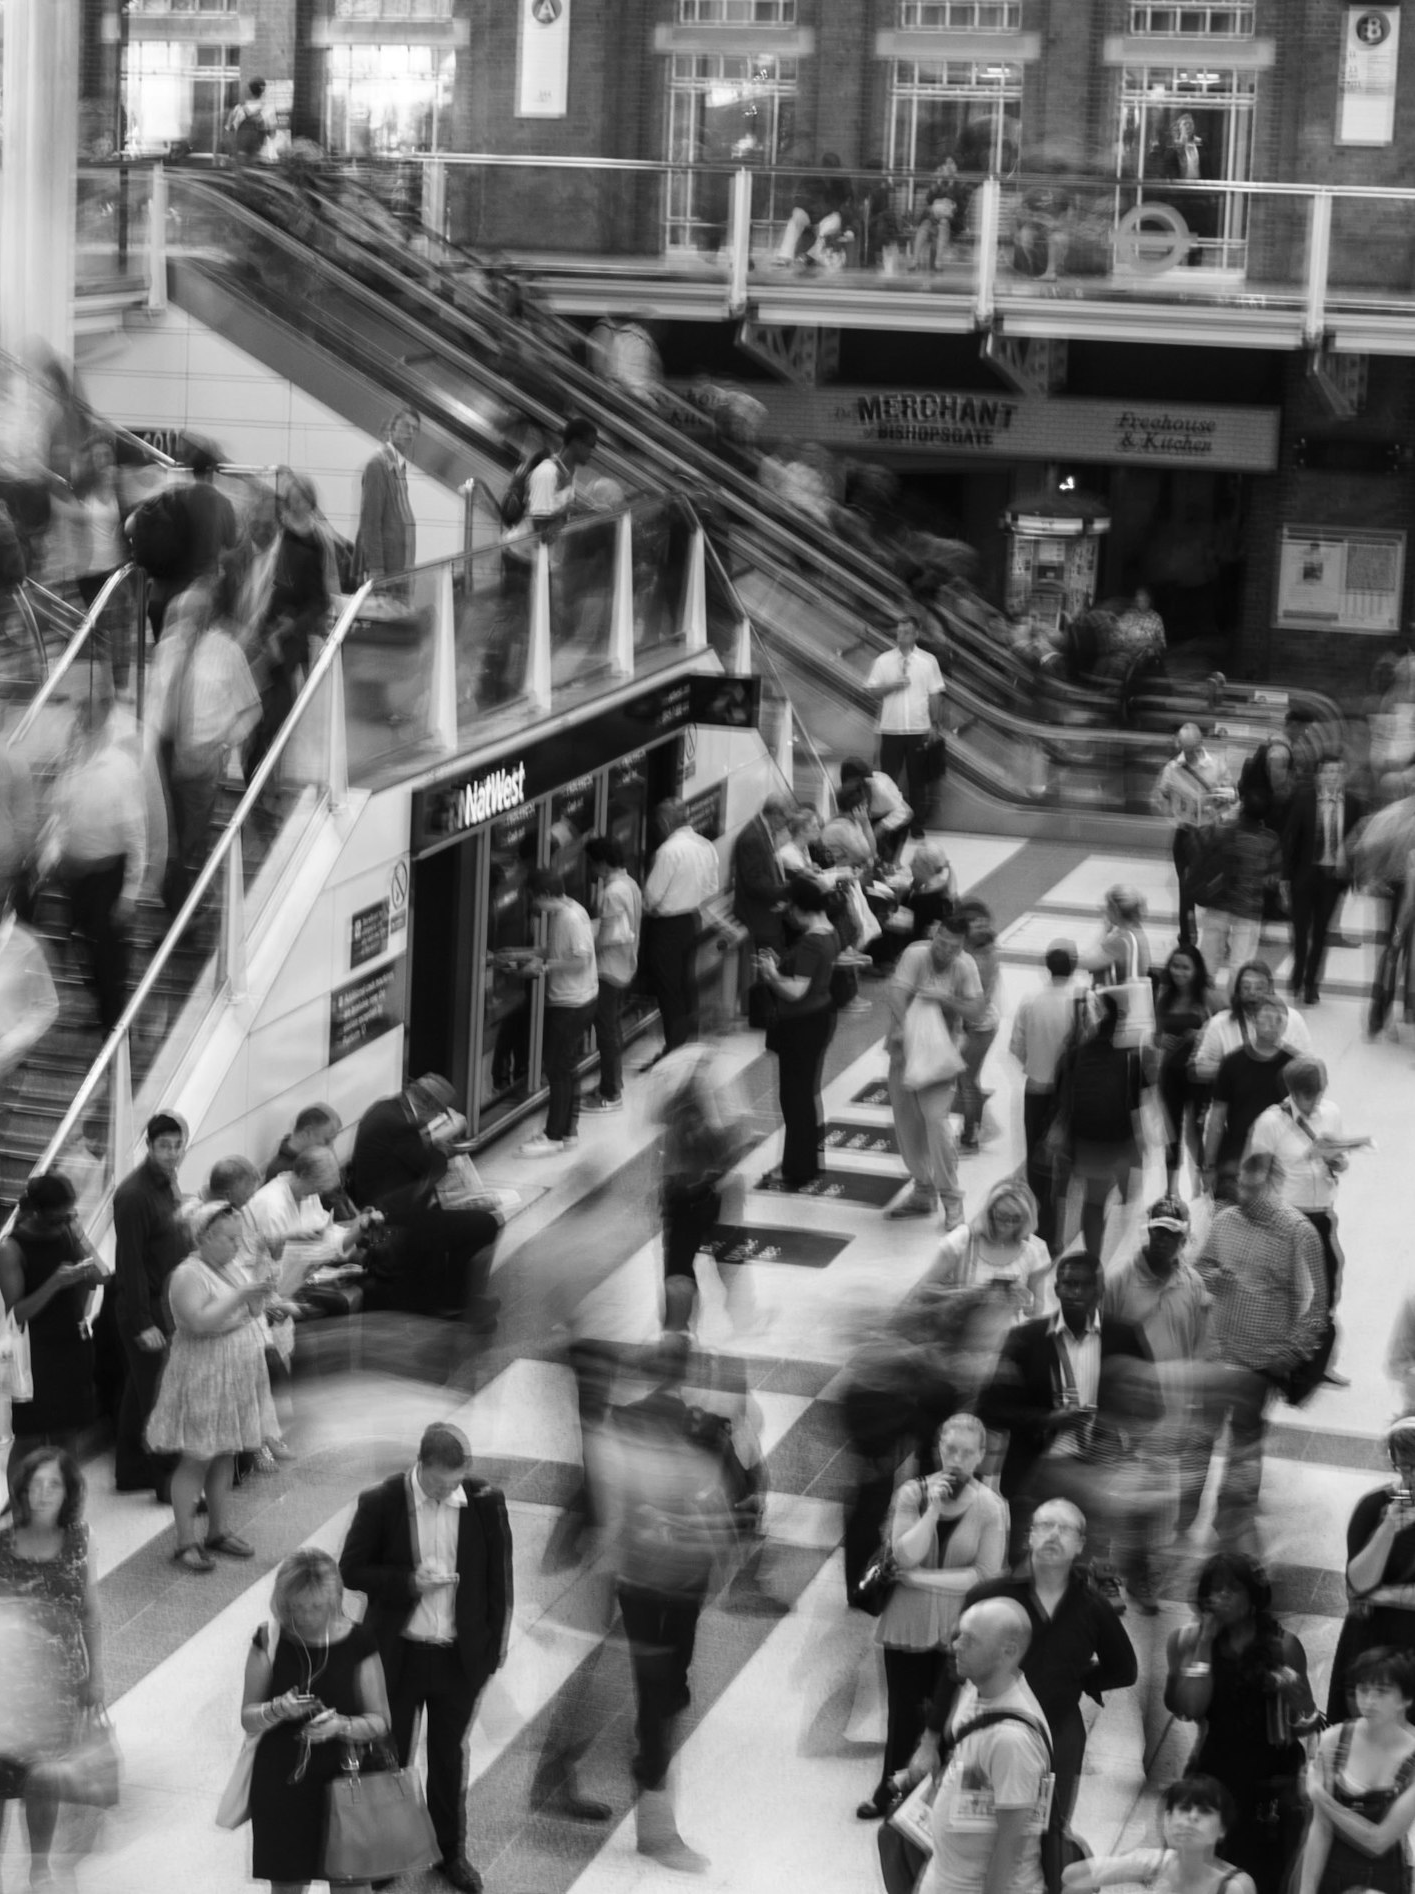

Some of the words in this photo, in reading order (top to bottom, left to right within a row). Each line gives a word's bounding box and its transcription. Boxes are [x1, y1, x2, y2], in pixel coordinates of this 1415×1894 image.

[857, 393, 1019, 429] MERCHANT
[1118, 411, 1217, 433] Freehouse
[878, 424, 995, 446] BISHOPSGATE
[1121, 430, 1135, 449] &
[1142, 431, 1212, 452] Kitchen
[463, 760, 526, 829] NatWest
